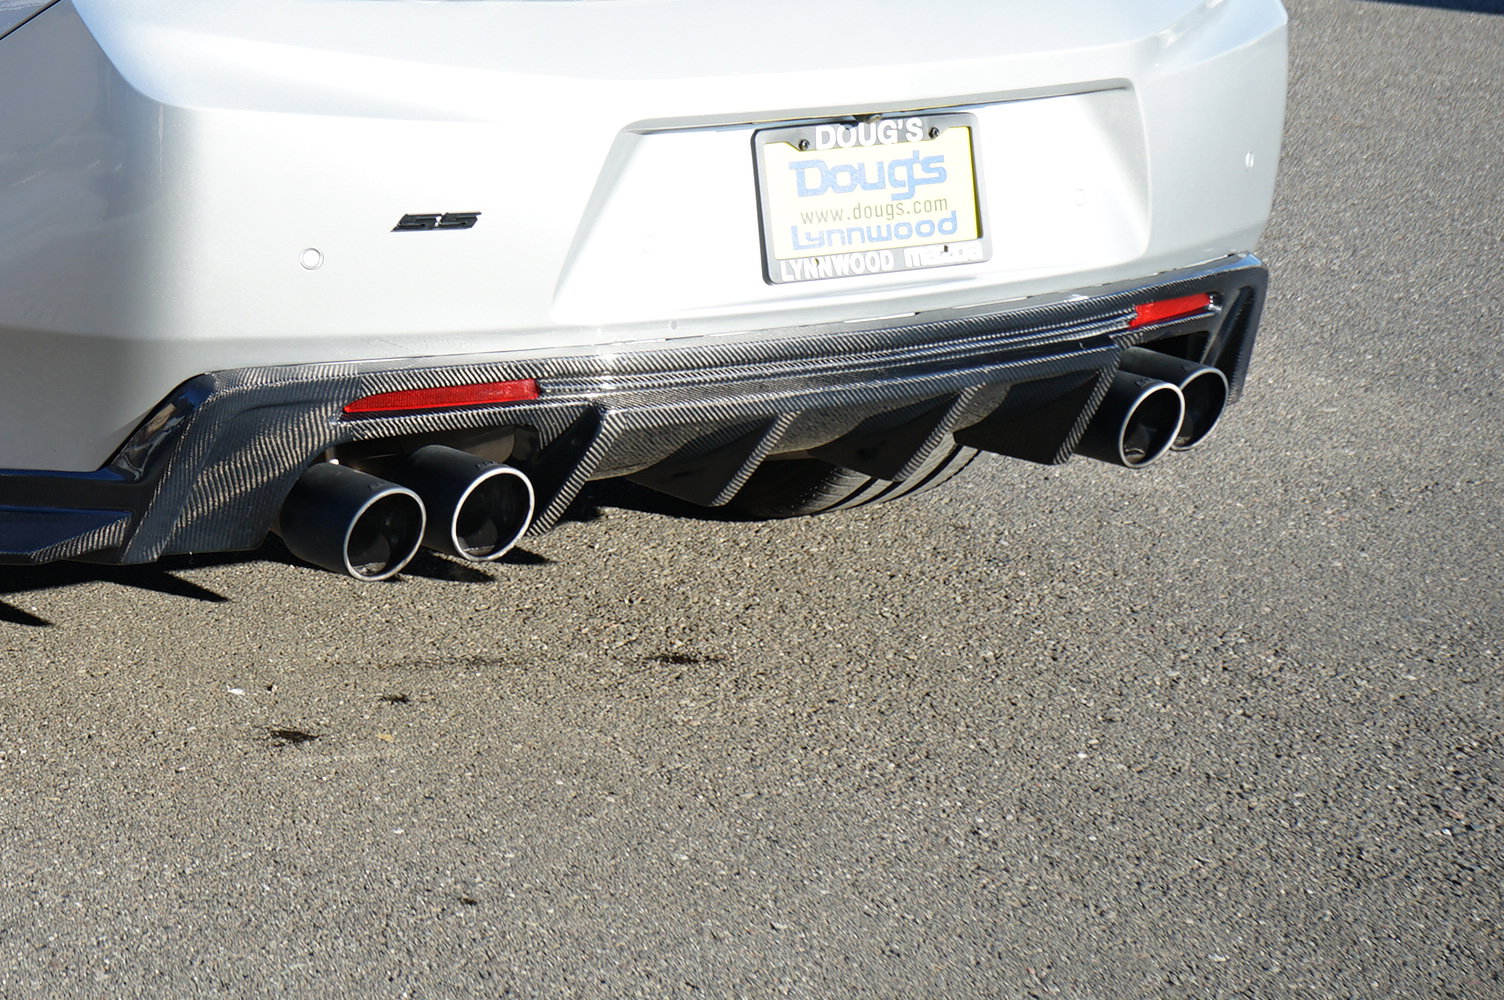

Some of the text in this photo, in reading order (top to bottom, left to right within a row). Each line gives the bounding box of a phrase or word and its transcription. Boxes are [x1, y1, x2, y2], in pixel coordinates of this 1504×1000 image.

[815, 118, 924, 150] DOUG'S
[800, 197, 948, 225] www.dougs.com
[790, 210, 958, 251] Lynnwood
[781, 250, 895, 282] LYNNWOOD
